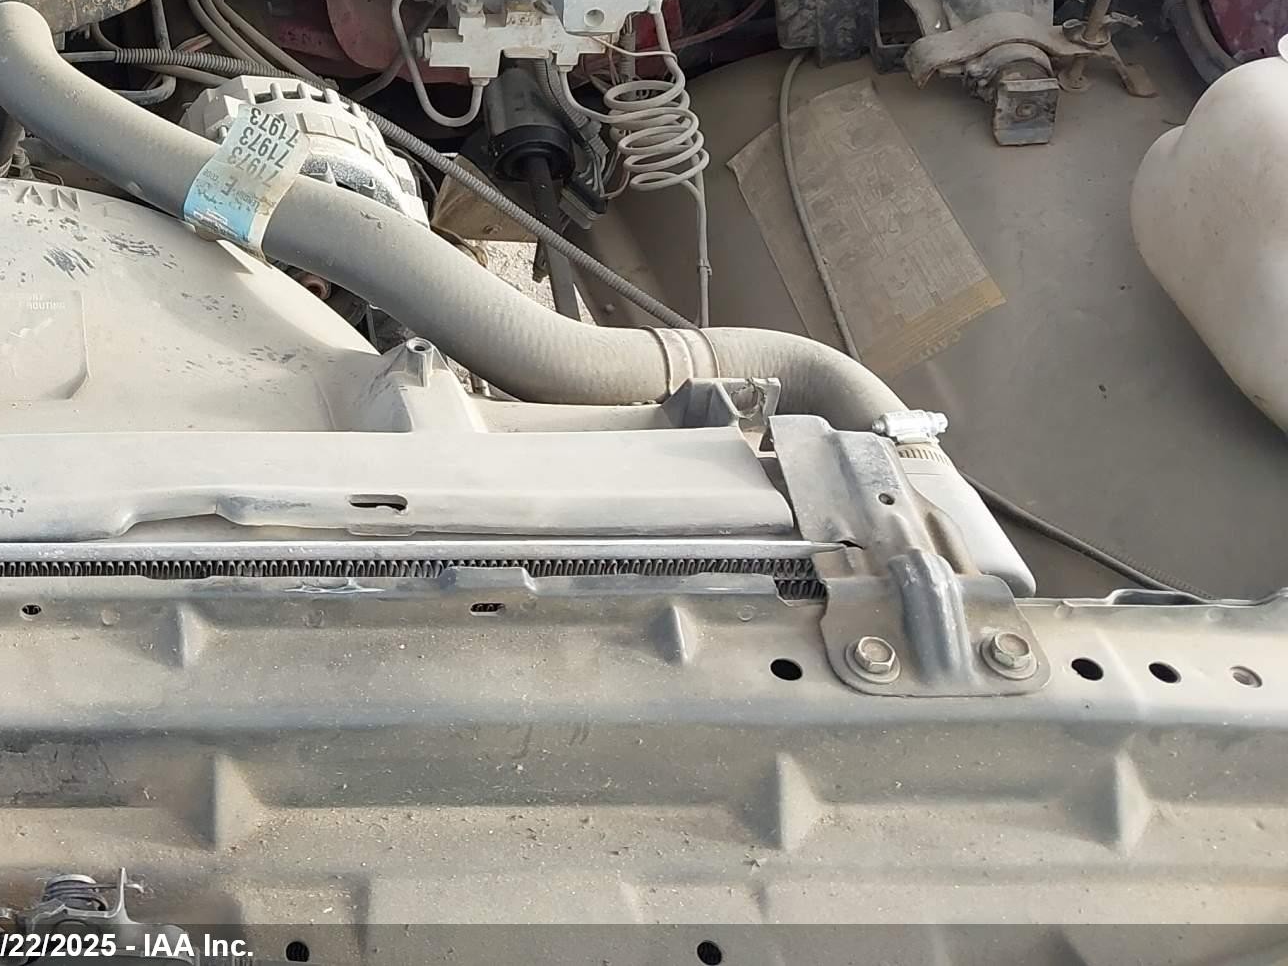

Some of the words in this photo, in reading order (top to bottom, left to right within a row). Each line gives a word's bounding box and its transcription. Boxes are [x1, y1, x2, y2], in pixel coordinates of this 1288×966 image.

[239, 126, 290, 169] 71973
[249, 107, 300, 148] 71973
[227, 146, 280, 186] 71973
